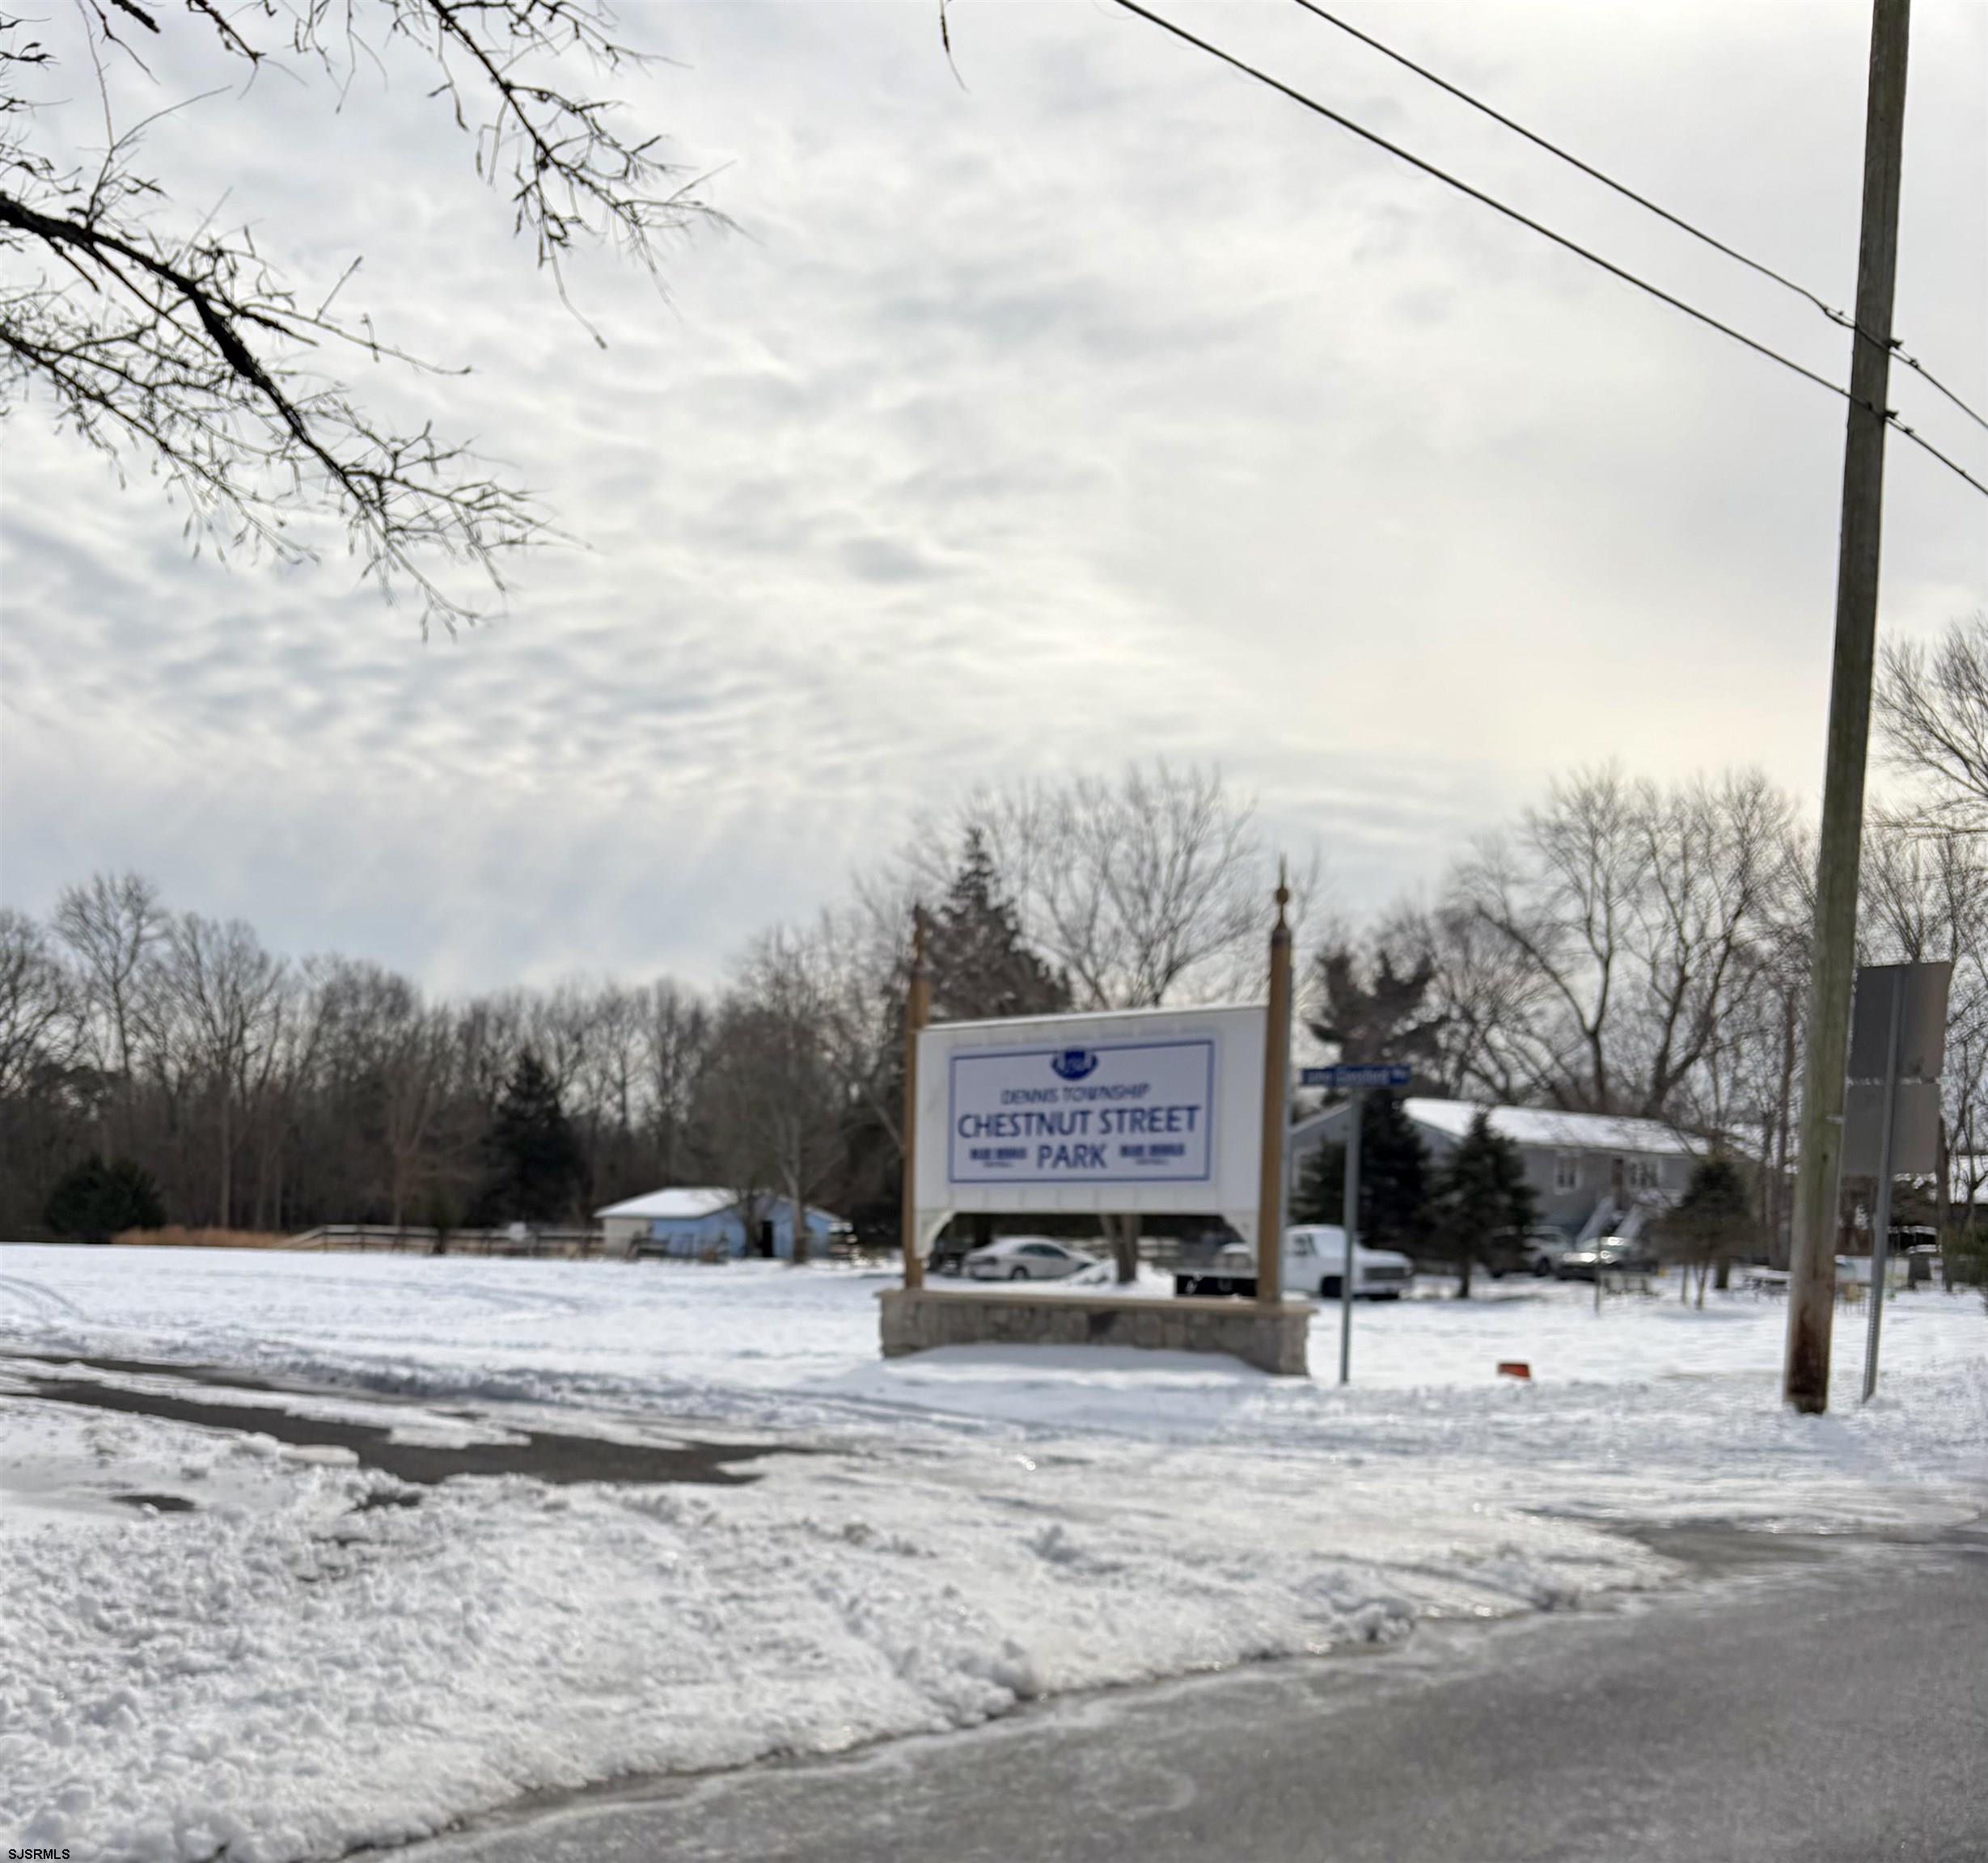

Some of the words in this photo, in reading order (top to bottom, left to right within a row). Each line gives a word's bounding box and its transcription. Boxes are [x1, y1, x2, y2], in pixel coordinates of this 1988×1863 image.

[1001, 1088, 1059, 1105] DENNIS
[1063, 1084, 1150, 1103] TOWNSHIP
[958, 1110, 1092, 1138] CHESTNUT
[1099, 1105, 1200, 1134] STREET
[1037, 1144, 1107, 1168] PARK
